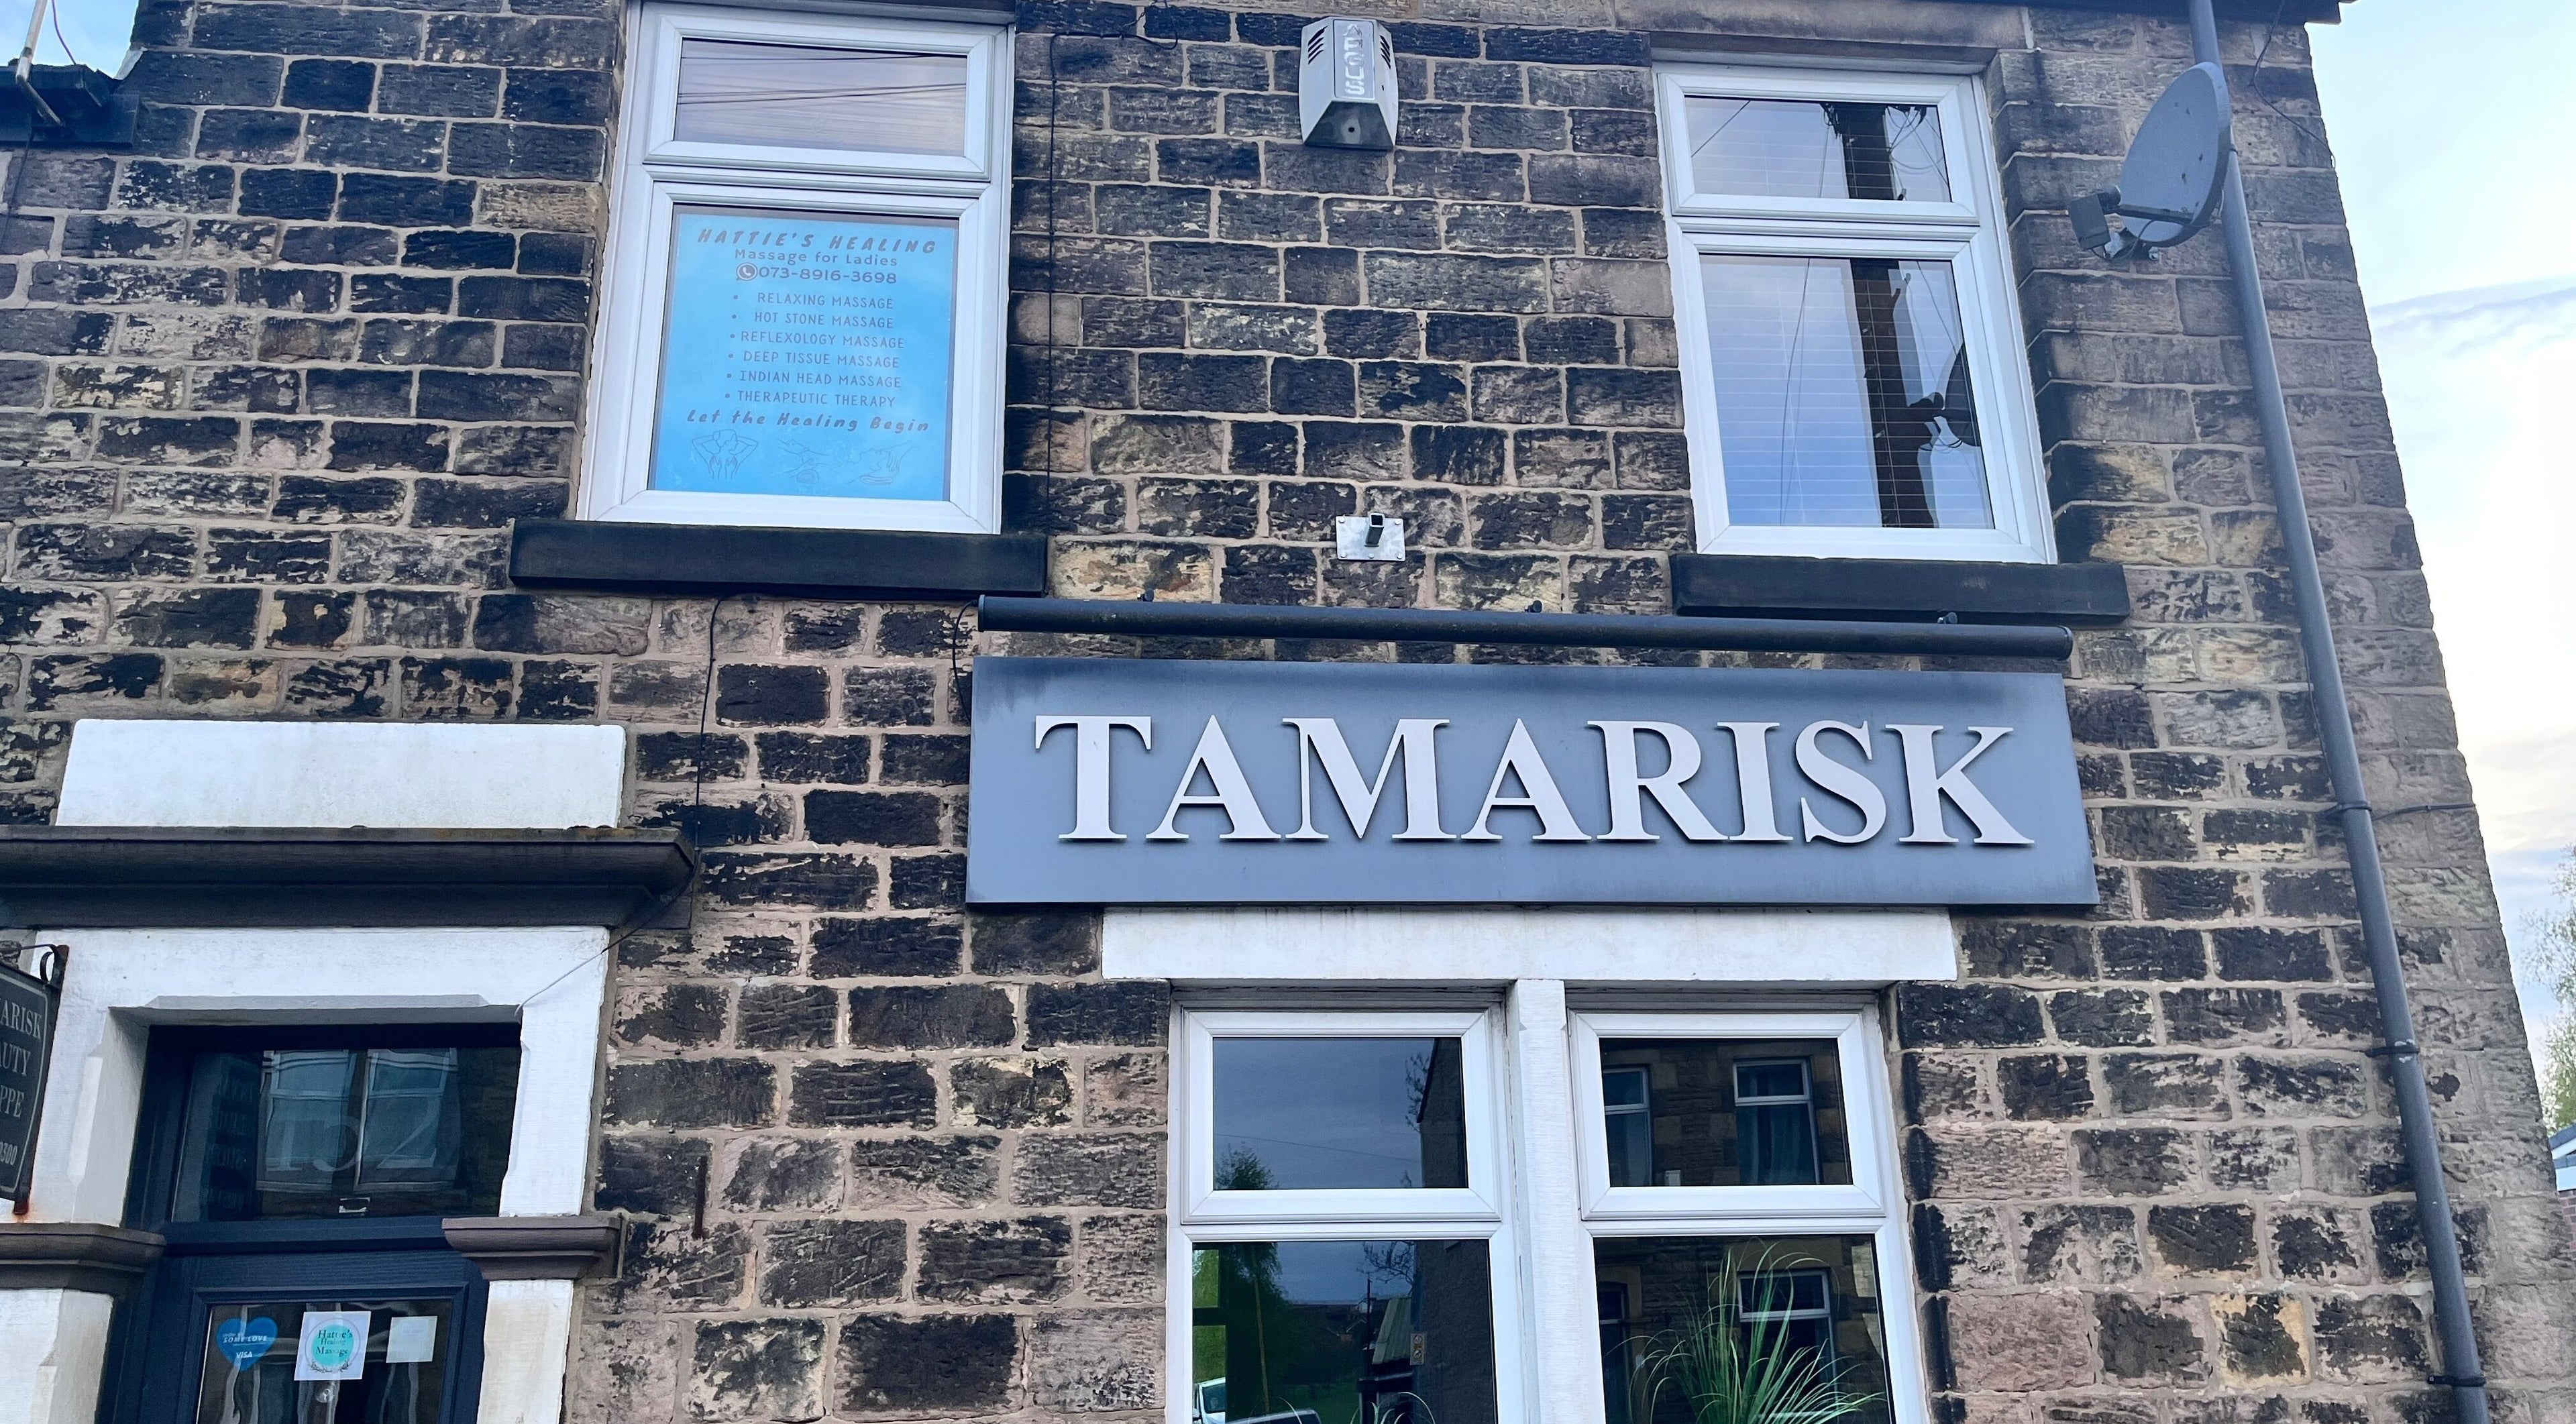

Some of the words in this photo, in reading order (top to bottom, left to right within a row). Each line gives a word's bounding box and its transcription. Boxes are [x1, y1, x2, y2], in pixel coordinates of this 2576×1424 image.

[698, 229, 814, 247] HATTIE'S
[828, 235, 936, 254] HEALING
[735, 249, 807, 266] Massage
[815, 252, 838, 263] for
[846, 254, 898, 266] Ladies
[759, 266, 897, 284] 073-8916-3698
[757, 292, 826, 306] RELAXING
[832, 296, 894, 309] MASSAGE
[755, 312, 778, 323] HOT
[785, 313, 824, 325] STONE
[832, 316, 894, 329] MASSAGE
[741, 331, 836, 345] REFLEXOLOGY
[843, 336, 905, 349] MASSAGE
[743, 351, 779, 363] DEEP
[786, 352, 830, 364] TISSUE
[837, 355, 900, 368] MASSAGE
[739, 370, 790, 383] INDIAN
[797, 373, 832, 384] HEAD
[839, 376, 901, 388] MASSAGE
[738, 390, 828, 405] THERAPEUTIC
[835, 394, 896, 408] THERAPY
[687, 409, 720, 424] Let
[732, 410, 765, 425] the
[777, 413, 858, 431] Healing
[869, 417, 929, 434] Begin
[1034, 714, 2035, 846] TAMARISK
[0, 997, 42, 1039] ARISK
[0, 1041, 30, 1077] UTY
[236, 1351, 253, 1359] VISA
